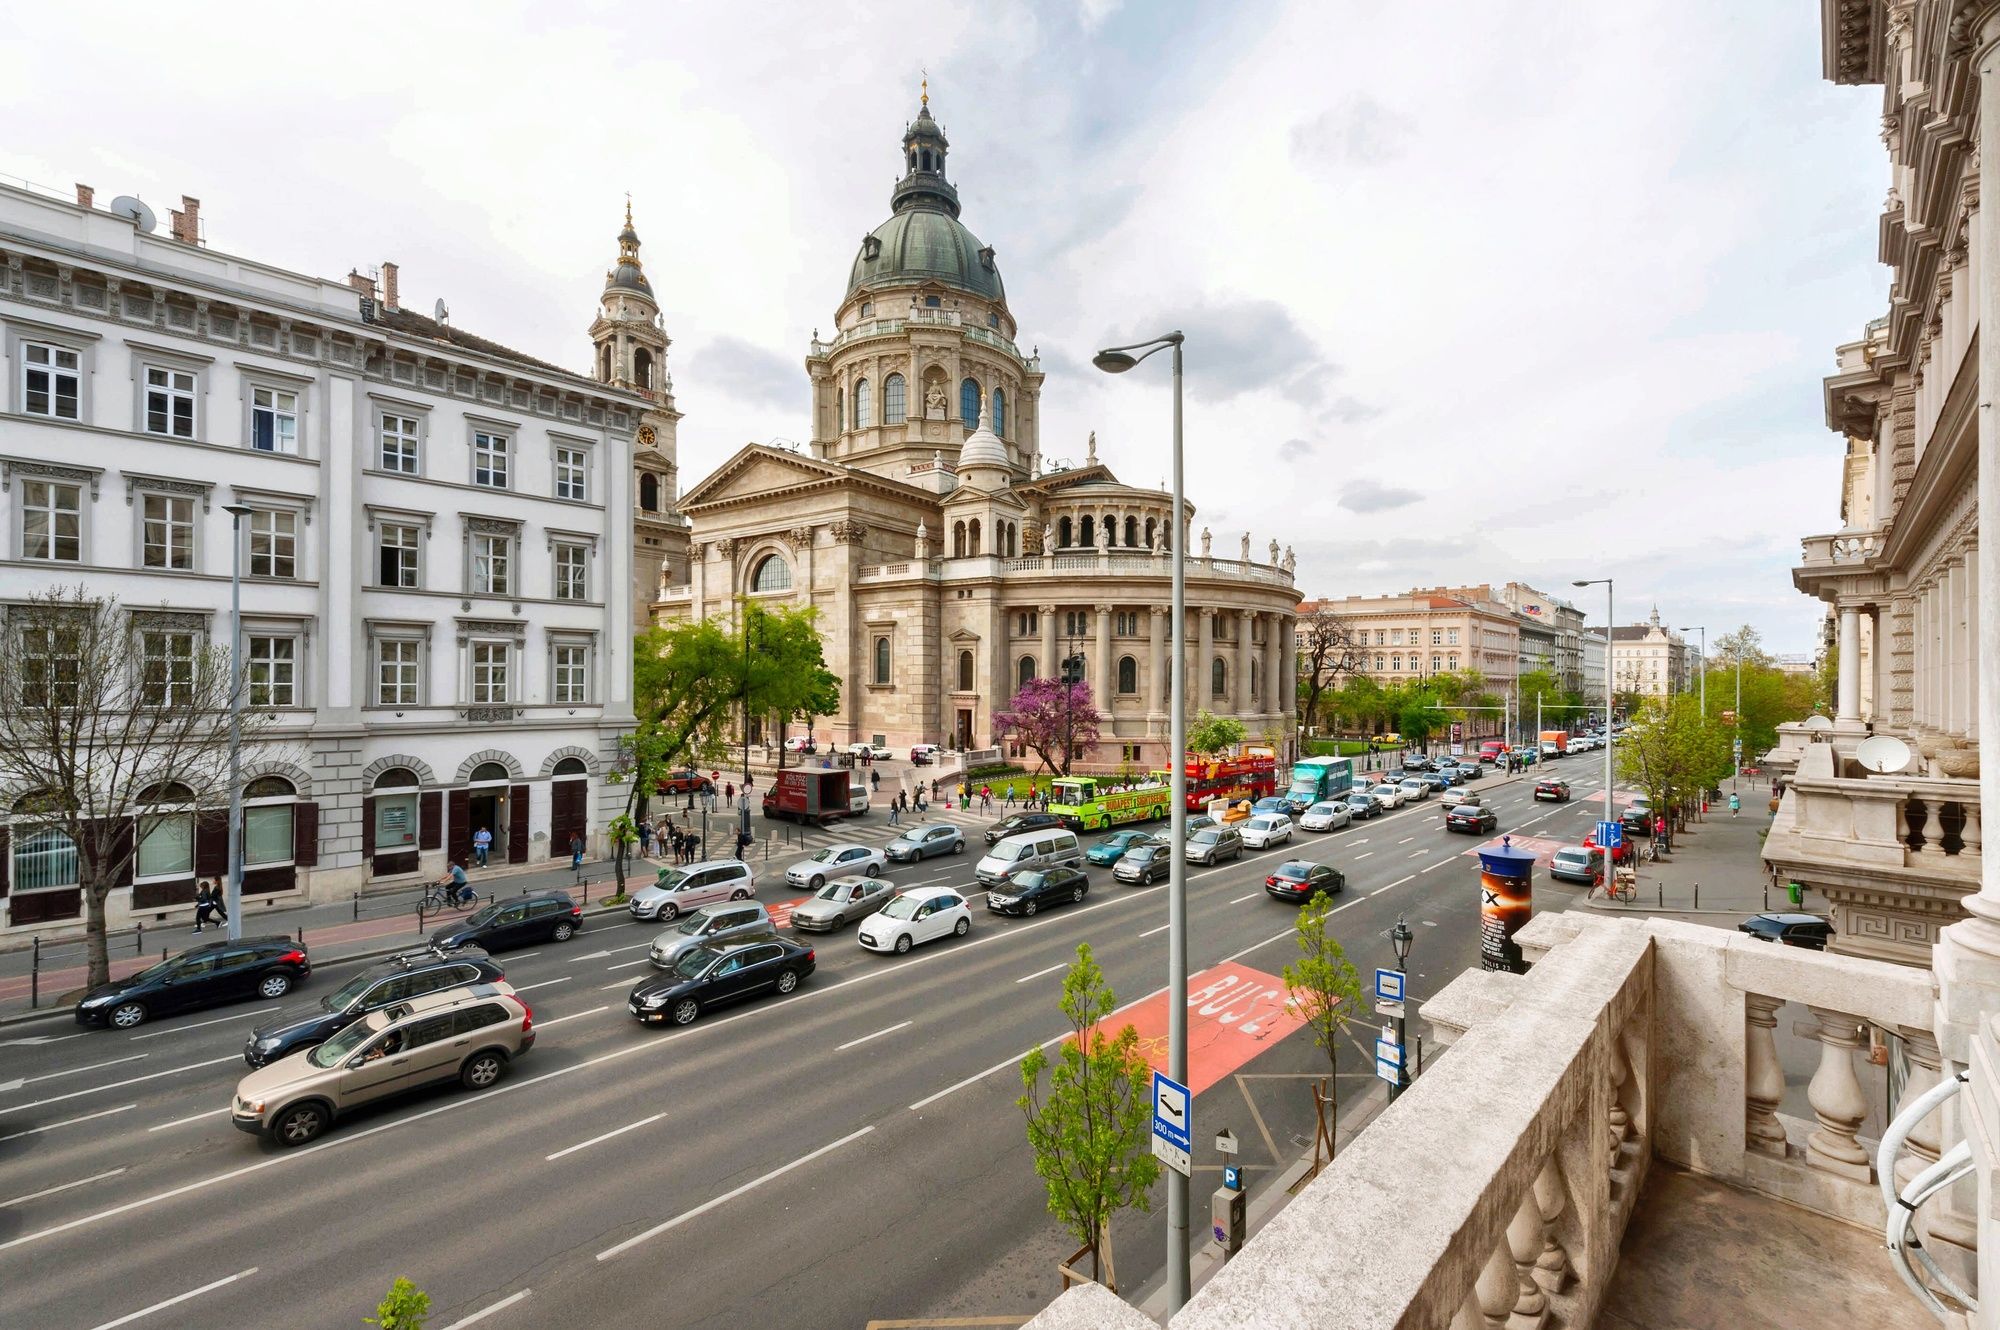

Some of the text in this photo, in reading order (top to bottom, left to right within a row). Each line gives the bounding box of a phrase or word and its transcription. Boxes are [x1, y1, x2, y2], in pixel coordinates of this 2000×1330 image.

[1154, 1119, 1174, 1140] 300 m
[1225, 1168, 1236, 1183] P
